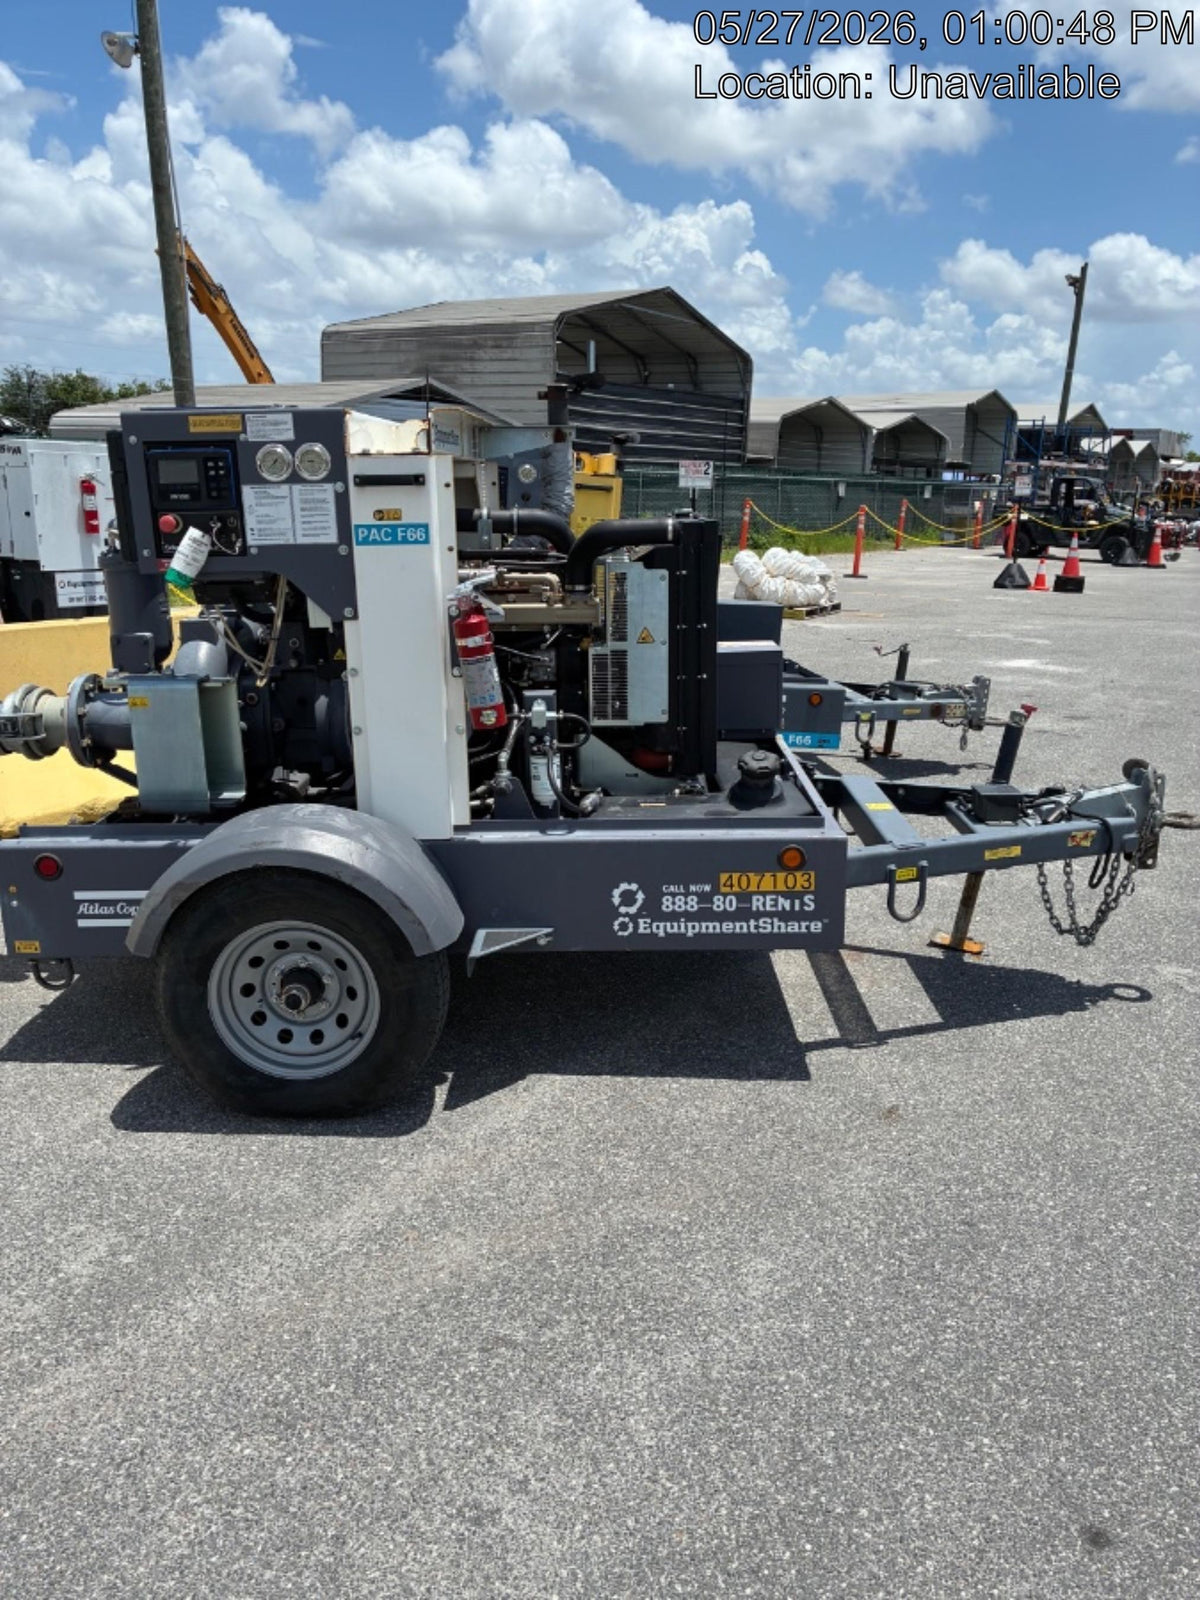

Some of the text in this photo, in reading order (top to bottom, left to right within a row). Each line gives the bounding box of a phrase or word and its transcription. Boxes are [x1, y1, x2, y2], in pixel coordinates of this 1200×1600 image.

[703, 461, 710, 476] 2
[357, 527, 427, 541] PAC F66
[662, 884, 712, 893] CALL NOW
[722, 872, 813, 891] 407103
[77, 902, 140, 916] Atlas Cop
[638, 917, 823, 937] EquipmentShare
